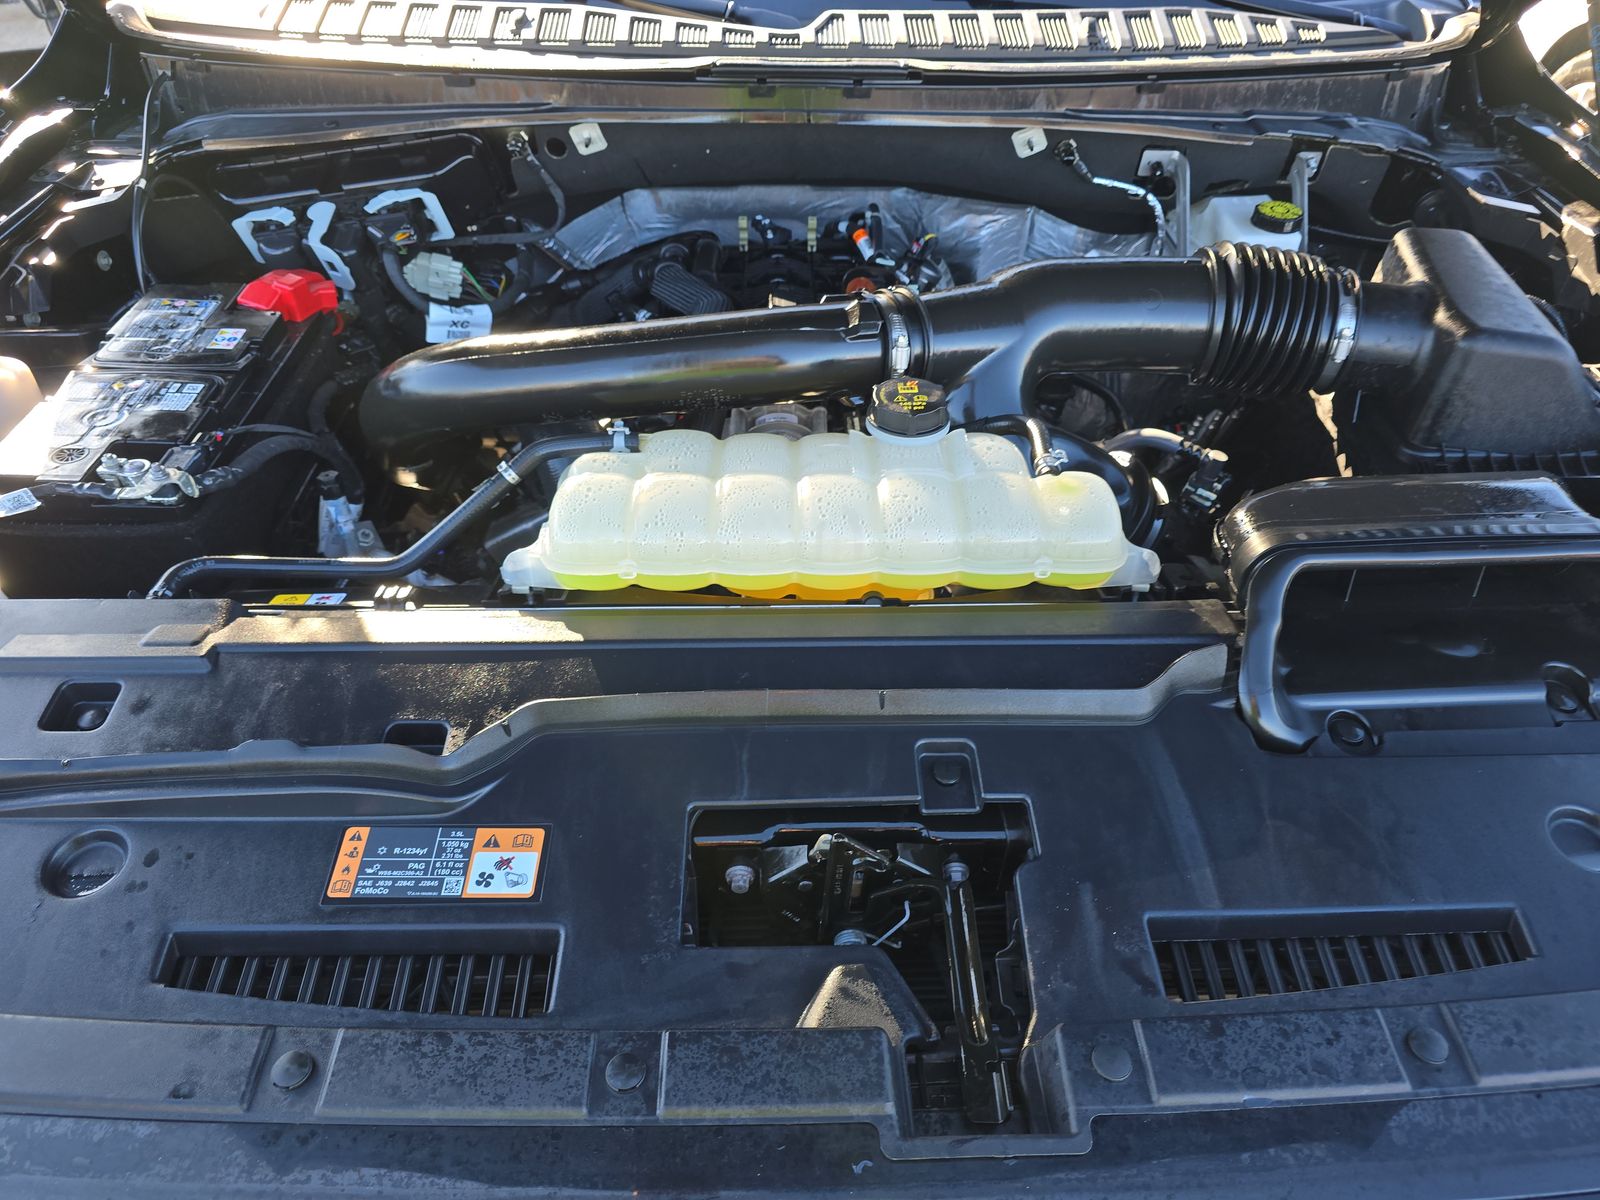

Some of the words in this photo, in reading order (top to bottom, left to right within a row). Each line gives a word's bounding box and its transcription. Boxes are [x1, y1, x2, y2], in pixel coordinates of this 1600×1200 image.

[460, 841, 469, 849] kg
[393, 847, 428, 856] R-1234yf
[407, 862, 425, 870] PAG
[354, 887, 389, 895] FoMoCo
